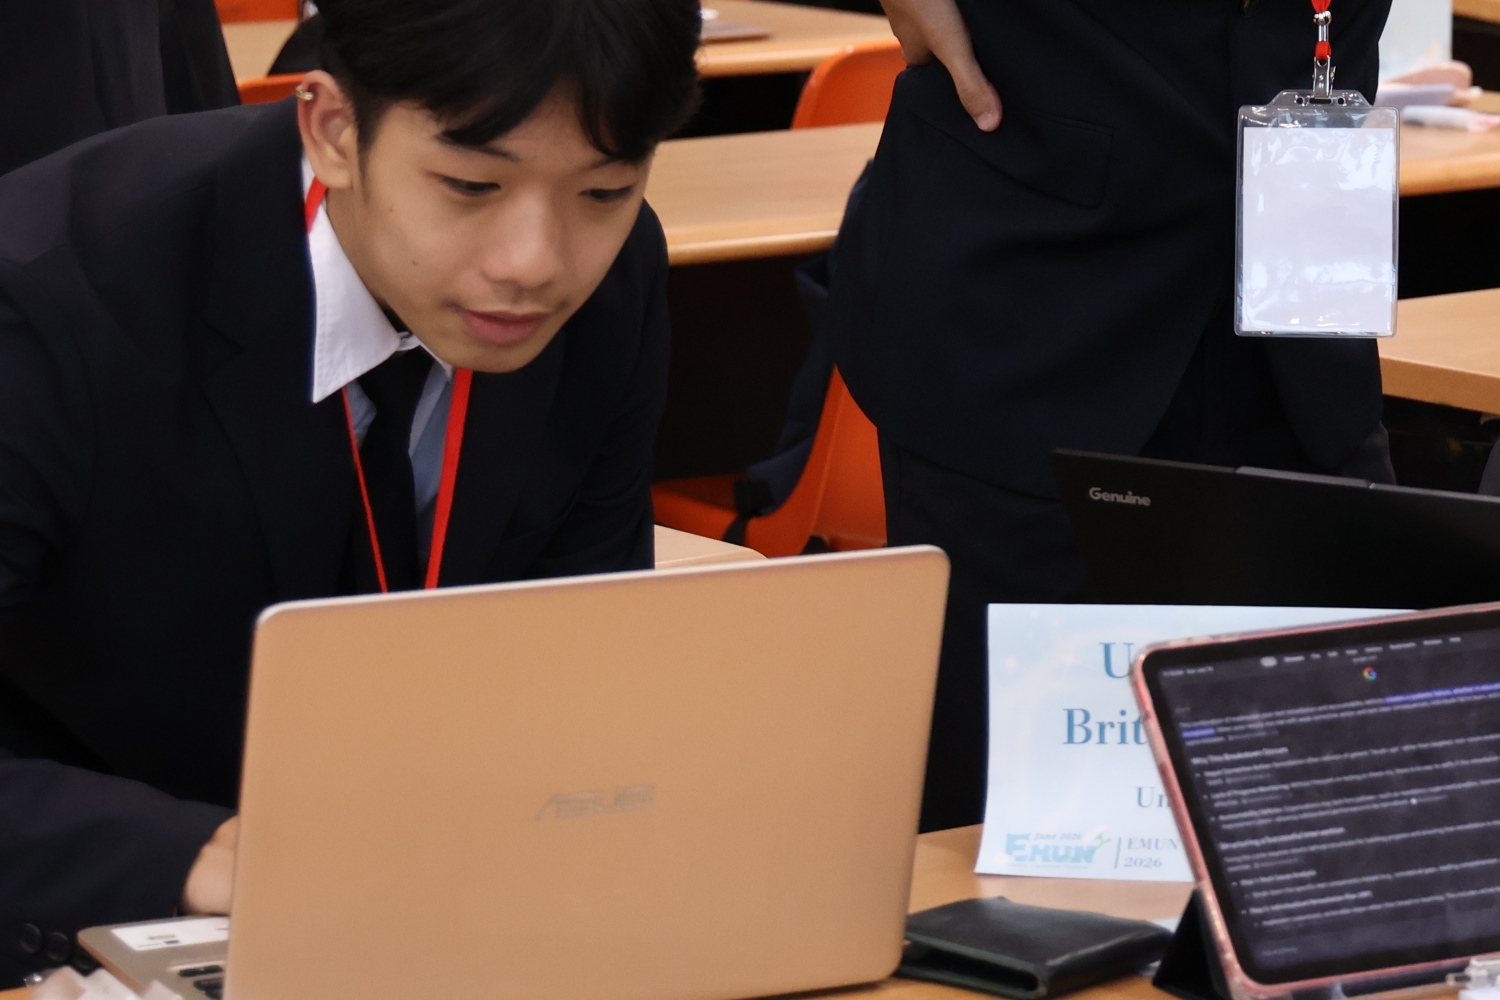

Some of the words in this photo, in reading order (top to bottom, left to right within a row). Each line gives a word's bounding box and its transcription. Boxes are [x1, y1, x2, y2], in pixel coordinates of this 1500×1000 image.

[1089, 487, 1152, 506] Genuine
[1062, 707, 1149, 745] Brit
[1127, 837, 1178, 850] EMUN
[1123, 857, 1163, 868] 2026
